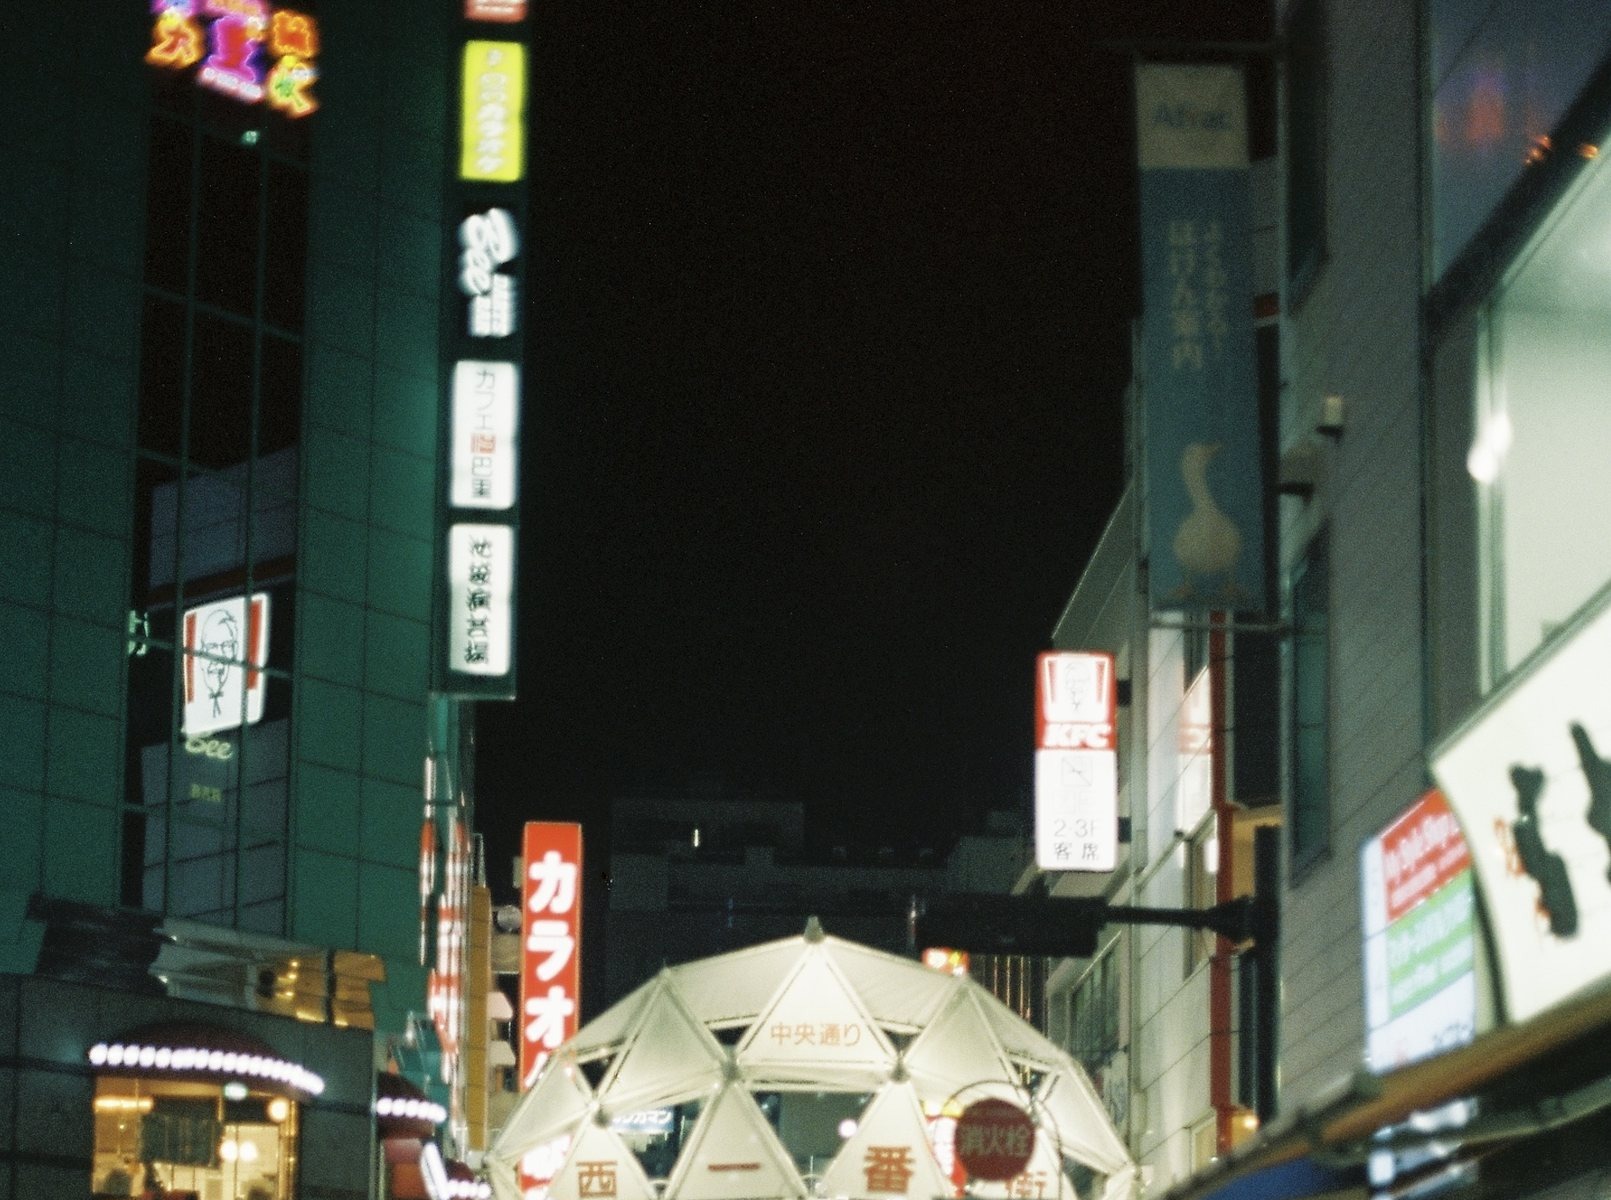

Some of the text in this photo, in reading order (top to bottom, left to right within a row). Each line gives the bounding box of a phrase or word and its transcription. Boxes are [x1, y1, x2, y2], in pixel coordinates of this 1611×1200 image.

[1043, 722, 1112, 748] KFC
[770, 1022, 862, 1047] 中央通り
[957, 1122, 1030, 1158] 消火栓
